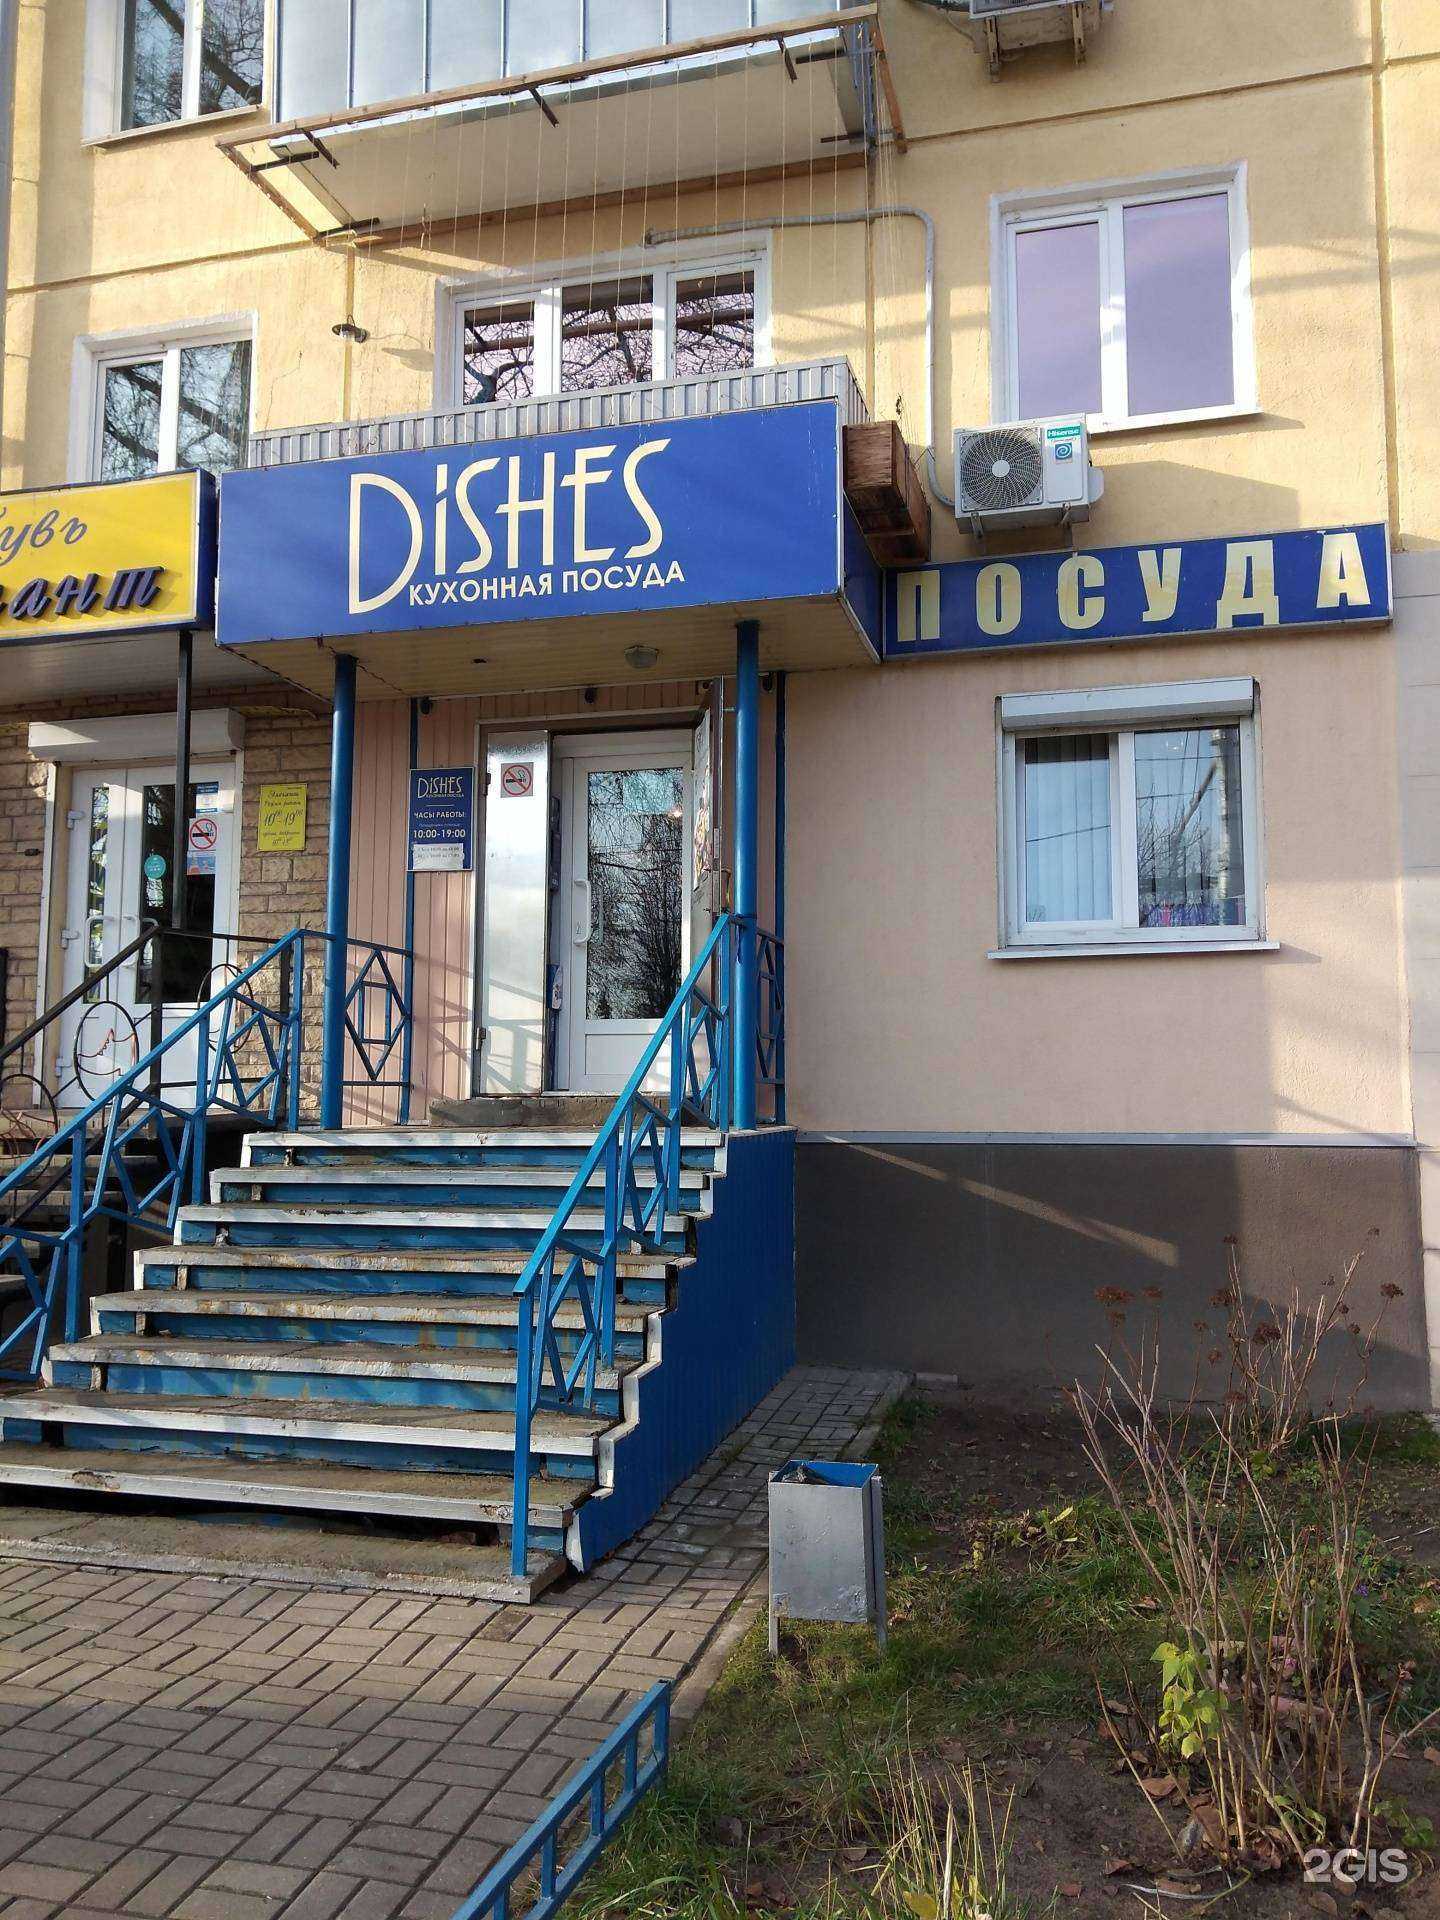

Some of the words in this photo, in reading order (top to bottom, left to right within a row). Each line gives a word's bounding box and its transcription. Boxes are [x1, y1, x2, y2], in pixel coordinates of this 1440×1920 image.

[0, 565, 166, 620] ант
[409, 575, 552, 606] КУХОННАЯ
[562, 560, 686, 593] ПОСУДА
[897, 532, 1371, 642] ПОСУДА
[414, 811, 435, 819] ЧАСЫ
